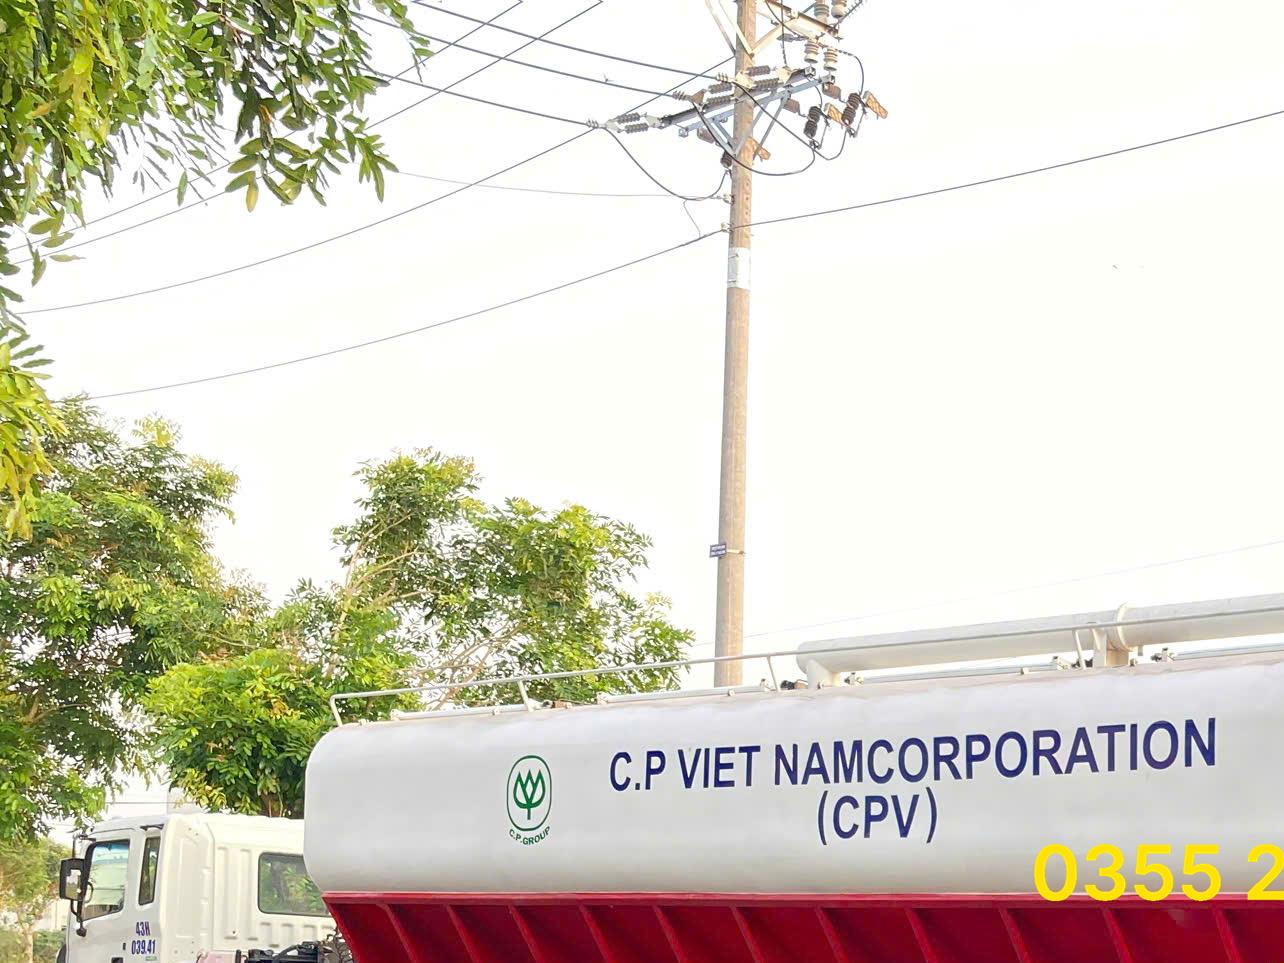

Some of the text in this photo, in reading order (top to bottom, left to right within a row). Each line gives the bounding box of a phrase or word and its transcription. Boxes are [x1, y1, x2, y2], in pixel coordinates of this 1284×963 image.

[610, 718, 1216, 792] C.P VIET NAMCORPORATION
[817, 787, 938, 845] (CPV)
[131, 939, 156, 955] 039.41
